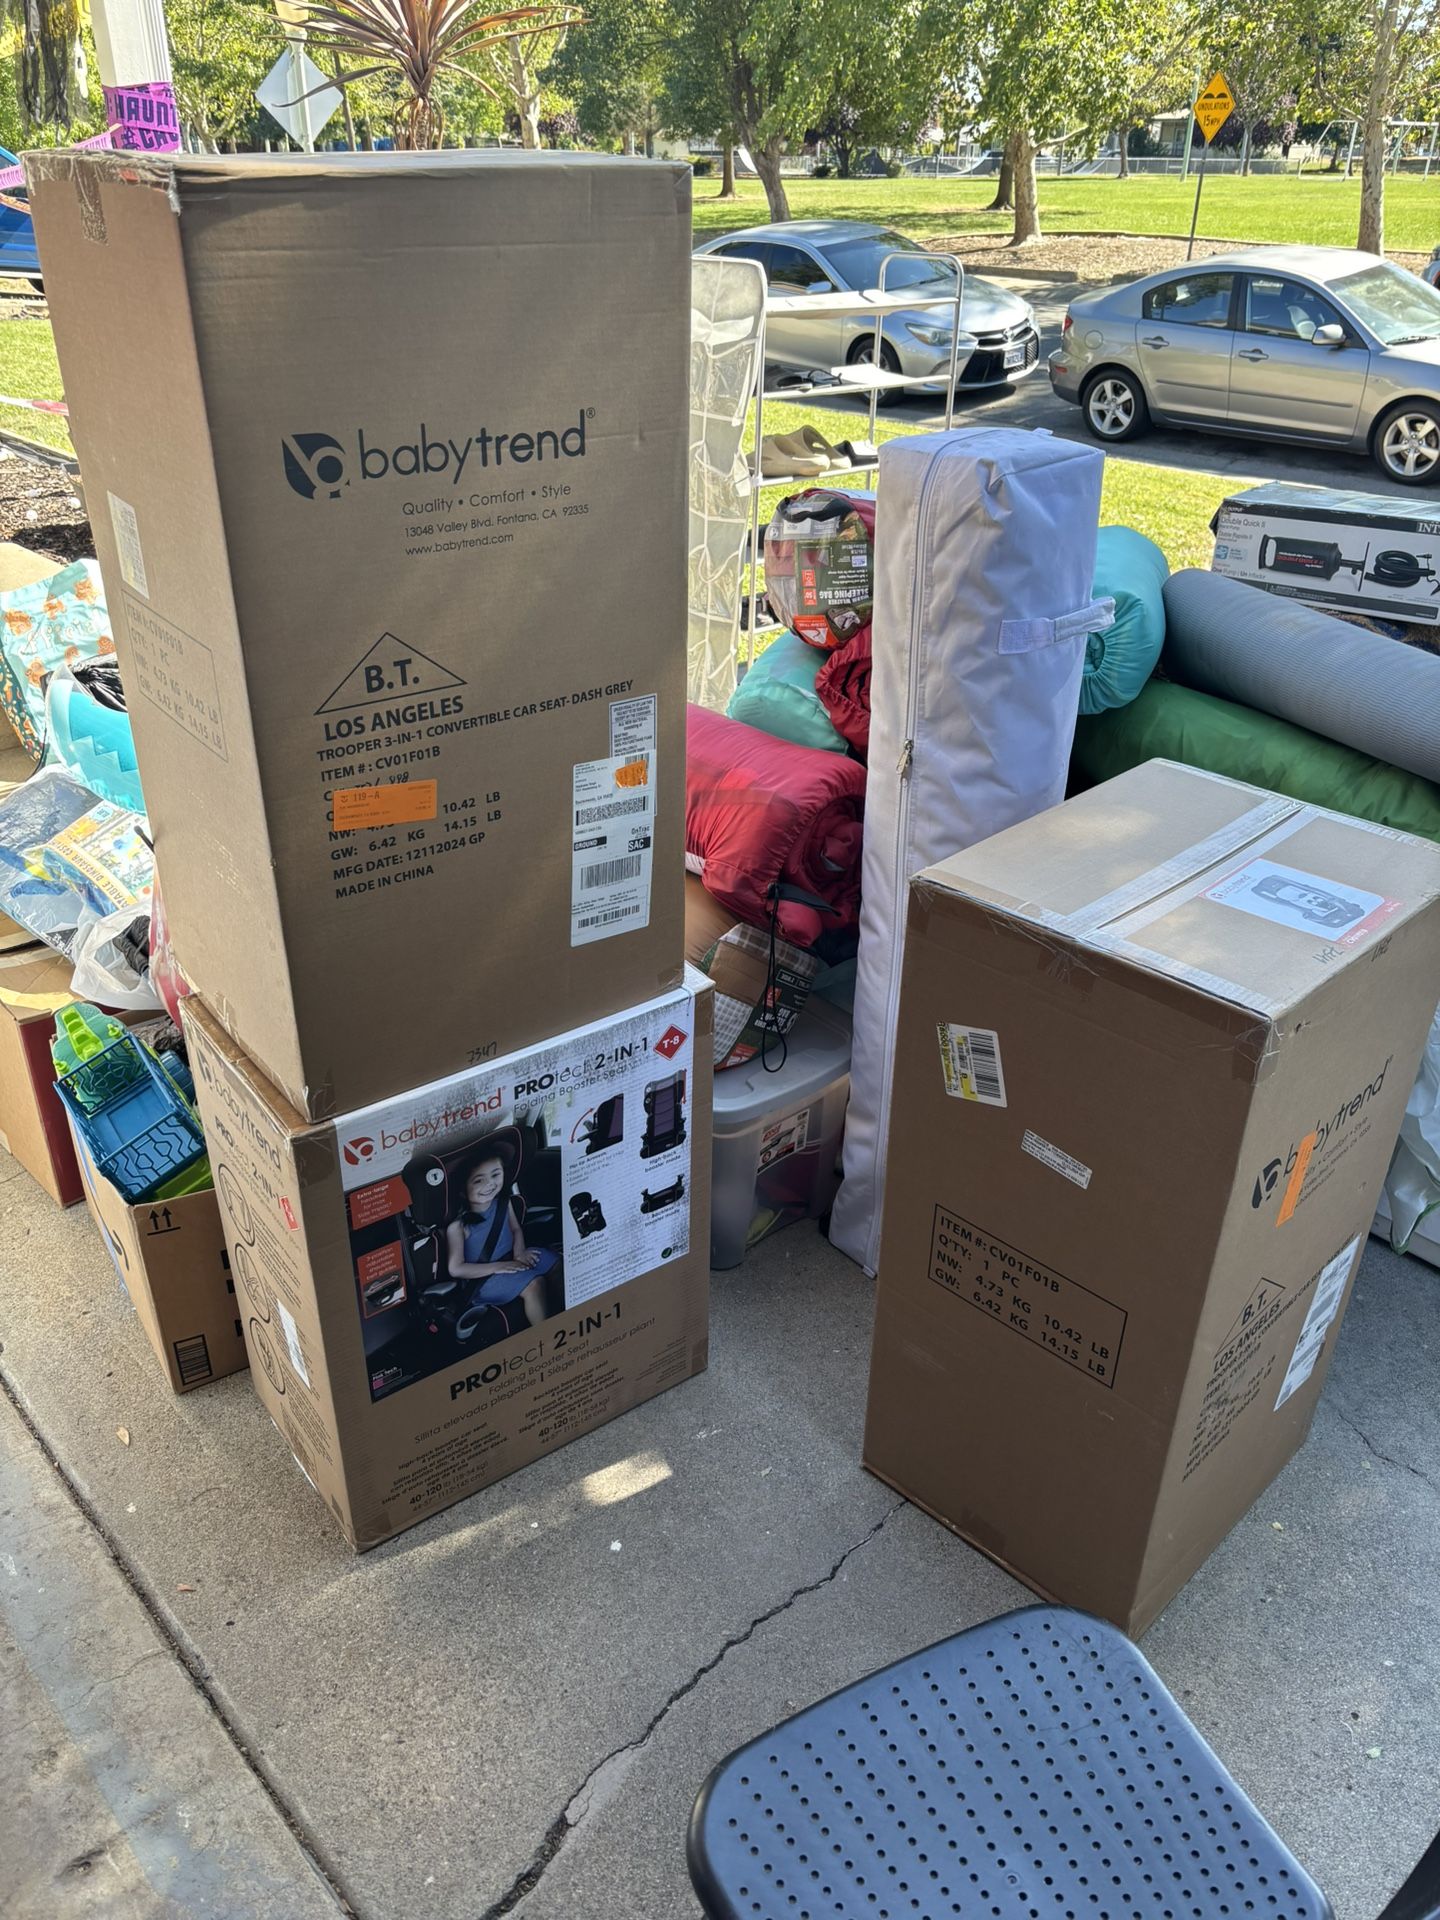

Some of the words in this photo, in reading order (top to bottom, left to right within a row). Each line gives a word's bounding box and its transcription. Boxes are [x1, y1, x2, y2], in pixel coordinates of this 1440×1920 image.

[402, 500, 453, 516] Quality
[469, 489, 525, 508] Comfort
[541, 484, 571, 499] Style
[405, 524, 434, 538] 13048
[436, 520, 468, 535] Valley
[542, 508, 557, 520] CA
[562, 504, 589, 517] 92335
[1220, 517, 1241, 527] Double
[1243, 517, 1260, 528] Quick
[405, 533, 514, 556] www.babytrend.com
[819, 591, 833, 599] BAG
[364, 658, 420, 694] B.T.
[317, 738, 382, 762] TROOPER
[385, 729, 424, 747] 3-IN-1
[426, 708, 511, 738] CONVERTIBLE
[513, 703, 537, 719] CAR
[572, 687, 603, 704] DASH
[605, 679, 634, 696] GREY
[324, 714, 366, 741] LOS
[371, 695, 464, 733] ANGELES
[321, 764, 355, 782] ITEM
[375, 746, 441, 770] CV01F01B
[442, 797, 476, 814] 10.42
[486, 791, 501, 804] LB
[330, 846, 358, 861] GW:
[368, 836, 397, 851] 6.42
[407, 828, 425, 842] KG
[444, 817, 477, 833] 14.15
[487, 809, 502, 823] LB
[629, 840, 644, 851] SAC
[333, 864, 363, 881] MFG
[366, 855, 403, 872] DATE:
[406, 838, 467, 861] 12112024
[469, 832, 486, 845] GP
[335, 881, 375, 899] MADE
[378, 877, 391, 888] IN
[394, 864, 434, 883] CHINA
[595, 1036, 648, 1070] 2-IN-1
[514, 1090, 556, 1112] Folding
[559, 1076, 600, 1096] Booster
[938, 1233, 972, 1261] Q'TY:
[983, 1260, 990, 1271] 1
[1001, 1270, 1021, 1288] PC
[941, 1215, 972, 1242] ITEM
[989, 1245, 1061, 1293] CV01F01B
[935, 1267, 961, 1290] GW:
[973, 1291, 1001, 1315] 6.42
[1010, 1312, 1029, 1331] KG
[1040, 1331, 1079, 1361] 14.15
[1087, 1359, 1105, 1377] LB
[936, 1250, 962, 1273] NW:
[975, 1275, 1004, 1297] 4.73
[1012, 1295, 1032, 1314] KG
[1043, 1314, 1082, 1345] 10.42
[1090, 1342, 1109, 1359] LB
[1241, 1289, 1268, 1327] B.T.
[450, 1340, 545, 1400] PROtect
[554, 1302, 621, 1350] 2-IN-1
[1213, 1345, 1235, 1374] LOS
[1236, 1299, 1281, 1346] ANGELES
[414, 1425, 441, 1444] Sillita
[443, 1403, 489, 1430] elevada
[490, 1377, 537, 1409] plegable
[548, 1359, 575, 1377] Siège
[576, 1332, 628, 1363] rehausseur
[629, 1317, 656, 1338] pliant
[488, 1370, 526, 1395] Folding
[529, 1353, 565, 1376] Booster
[567, 1339, 589, 1356] Seat
[538, 1417, 568, 1437] 40-120
[409, 1483, 442, 1505] 40-120
